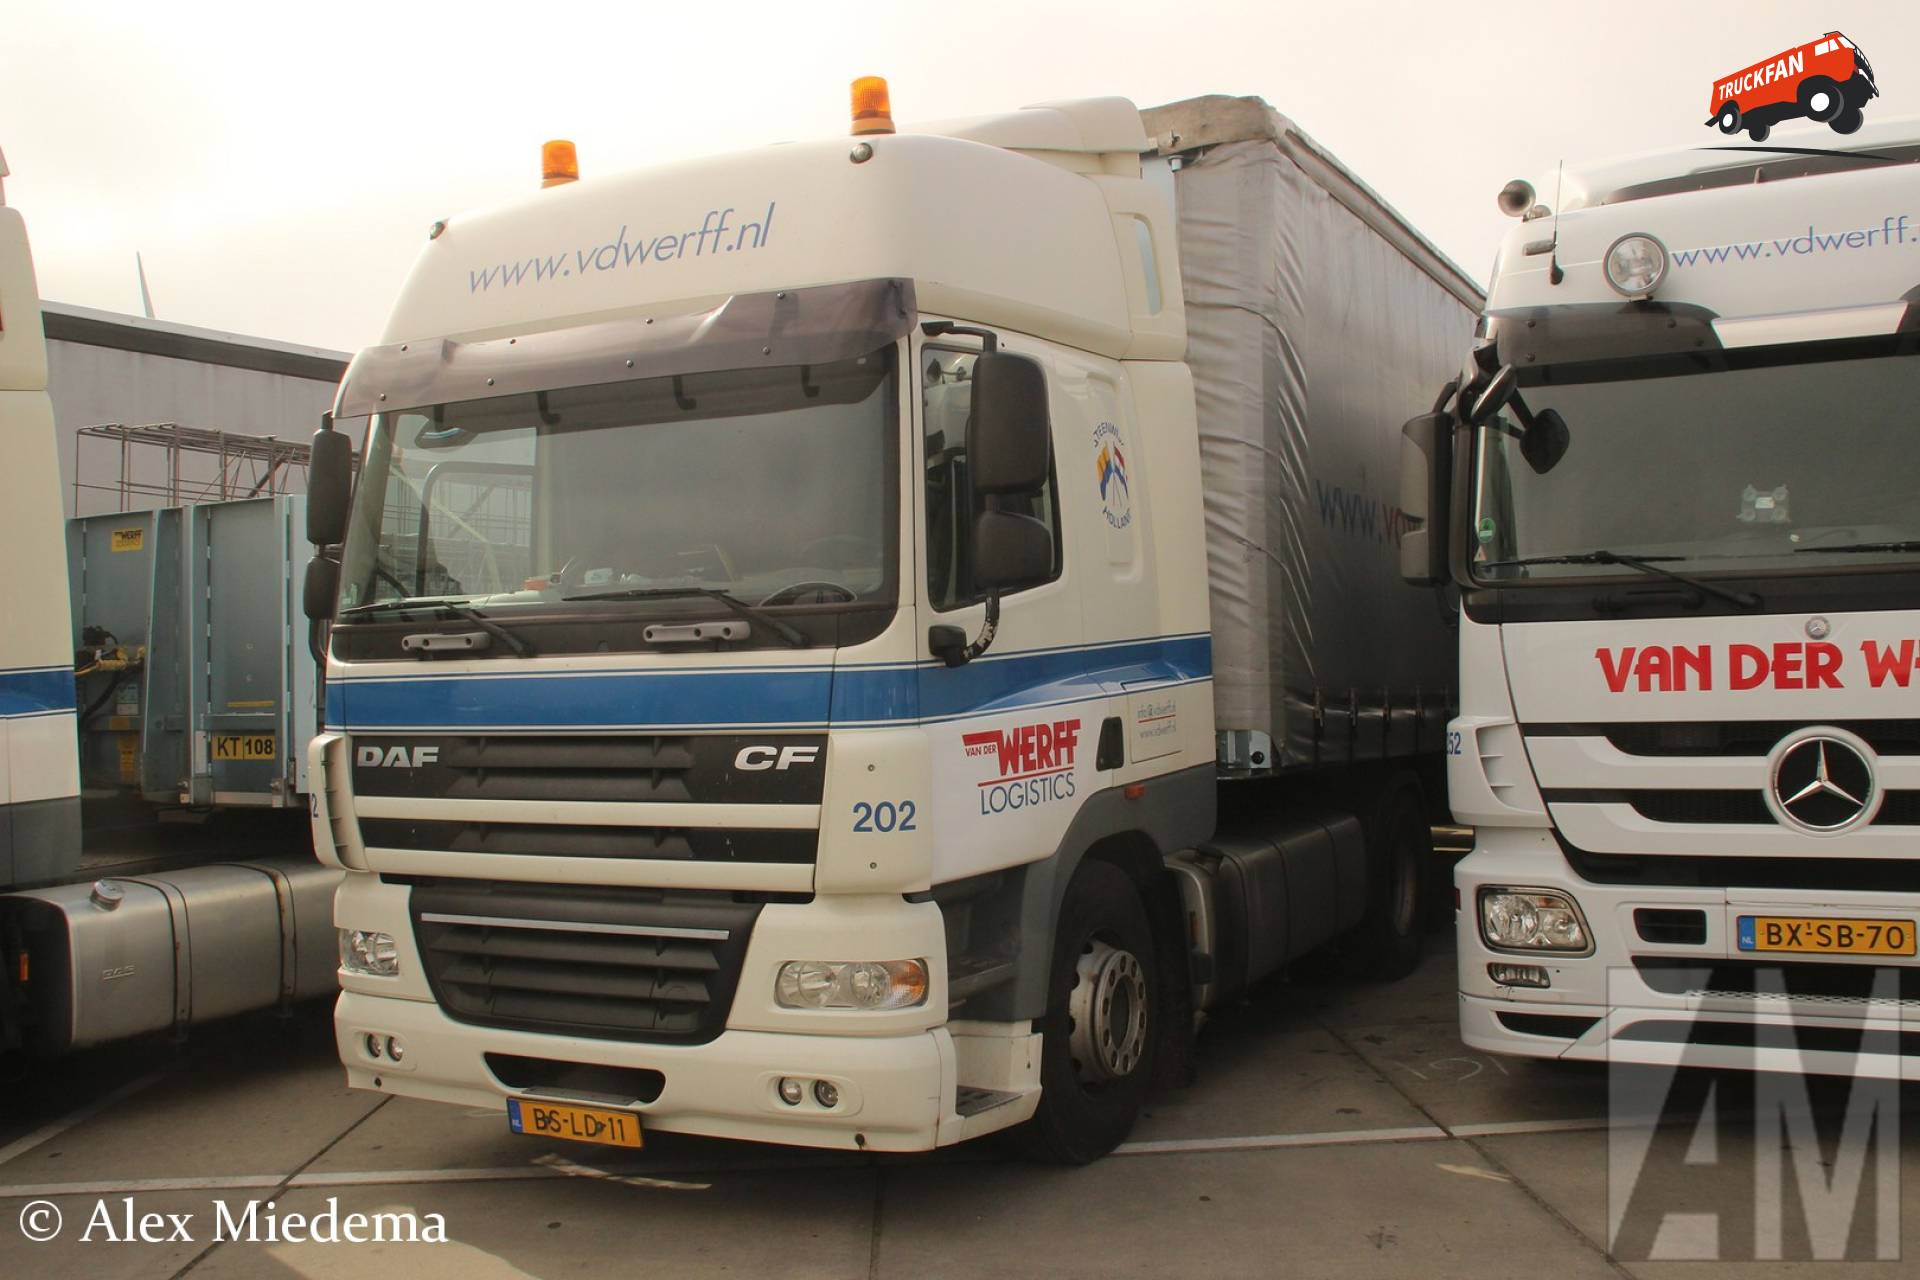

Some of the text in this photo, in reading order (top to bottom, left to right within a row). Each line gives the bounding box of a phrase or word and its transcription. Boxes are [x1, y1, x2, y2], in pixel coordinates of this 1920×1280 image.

[469, 201, 775, 294] www.vdwerff.nl
[1595, 640, 1920, 692] VAN DER W
[217, 738, 273, 757] KT 108
[357, 746, 440, 768] DAF
[735, 745, 820, 771] CF
[965, 743, 997, 758] VAN DER
[998, 718, 1081, 776] WERFF
[980, 772, 1075, 815] LOGISTICS
[853, 801, 917, 832] 202
